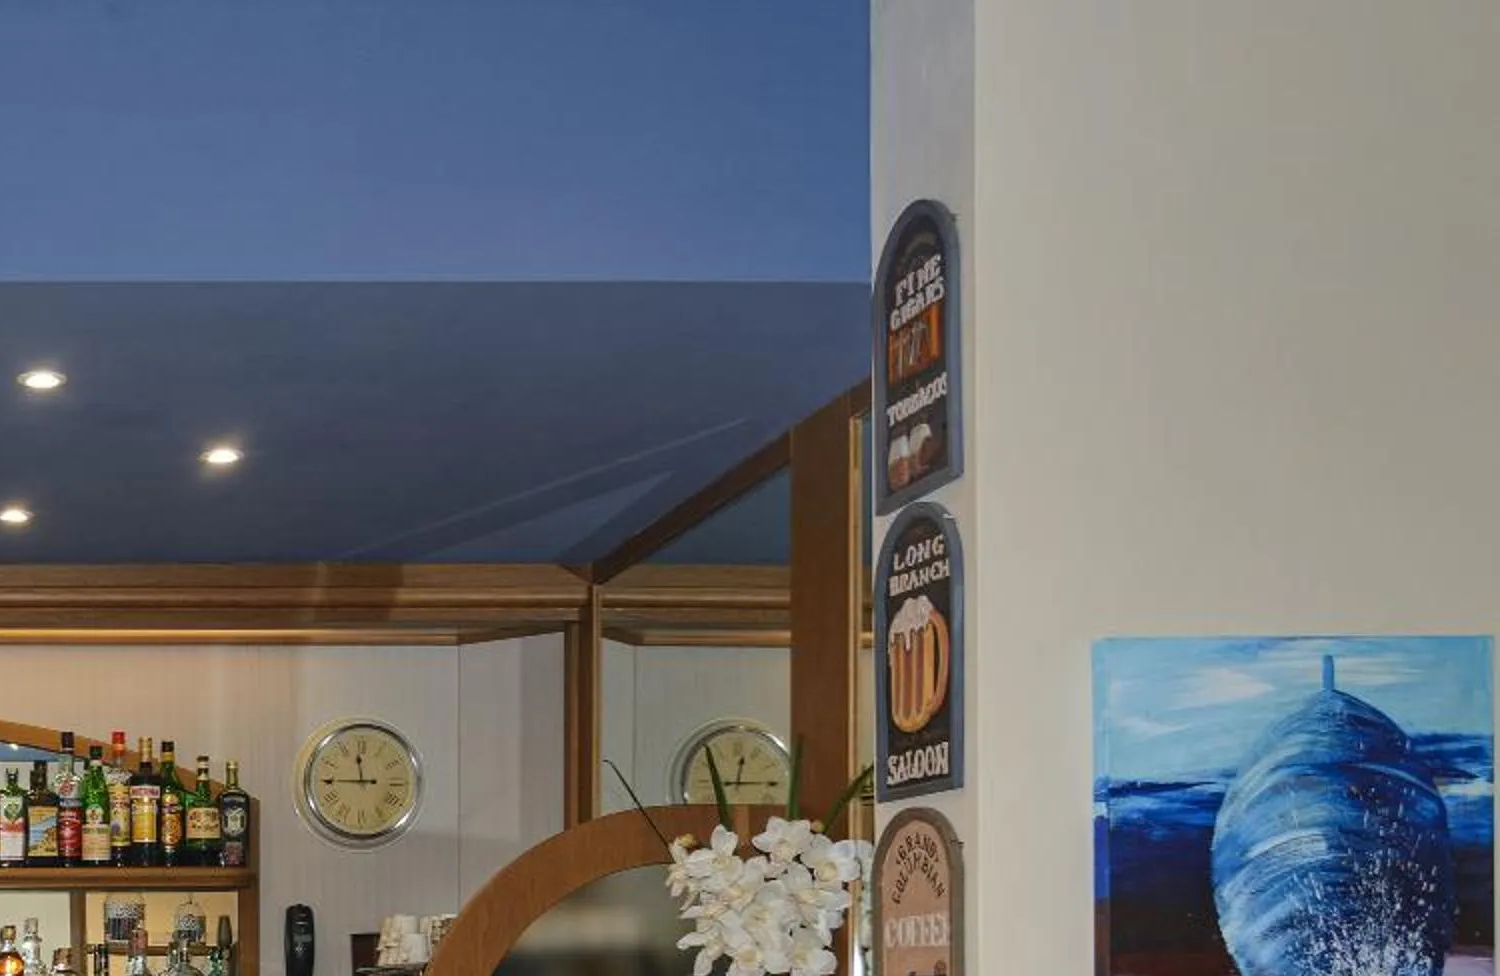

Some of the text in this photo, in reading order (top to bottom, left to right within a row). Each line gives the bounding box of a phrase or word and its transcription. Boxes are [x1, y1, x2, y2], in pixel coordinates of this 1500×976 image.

[893, 534, 945, 571] LONG
[889, 559, 950, 597] BRANCH
[887, 741, 949, 786] SALOON
